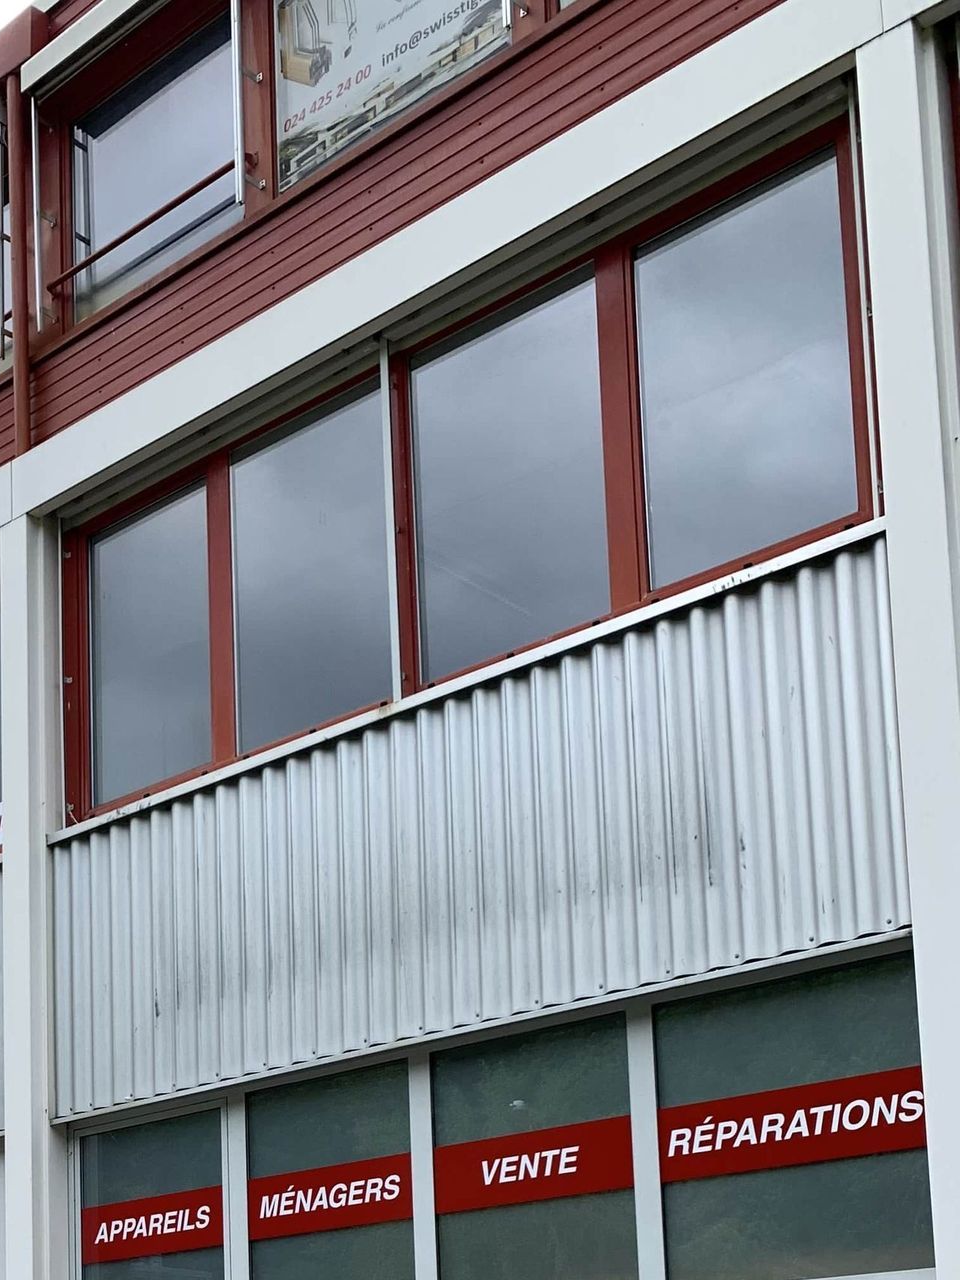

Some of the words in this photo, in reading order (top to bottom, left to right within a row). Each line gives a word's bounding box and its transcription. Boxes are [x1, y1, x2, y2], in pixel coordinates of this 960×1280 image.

[284, 108, 306, 133] 024
[310, 90, 332, 116] 425
[336, 78, 352, 99] 24
[355, 64, 372, 85] 00
[667, 1089, 925, 1158] RÉPARATIONS
[481, 1145, 580, 1186] VENTE
[259, 1174, 401, 1220] MÉNAGERS
[94, 1205, 211, 1245] APPAREILS
